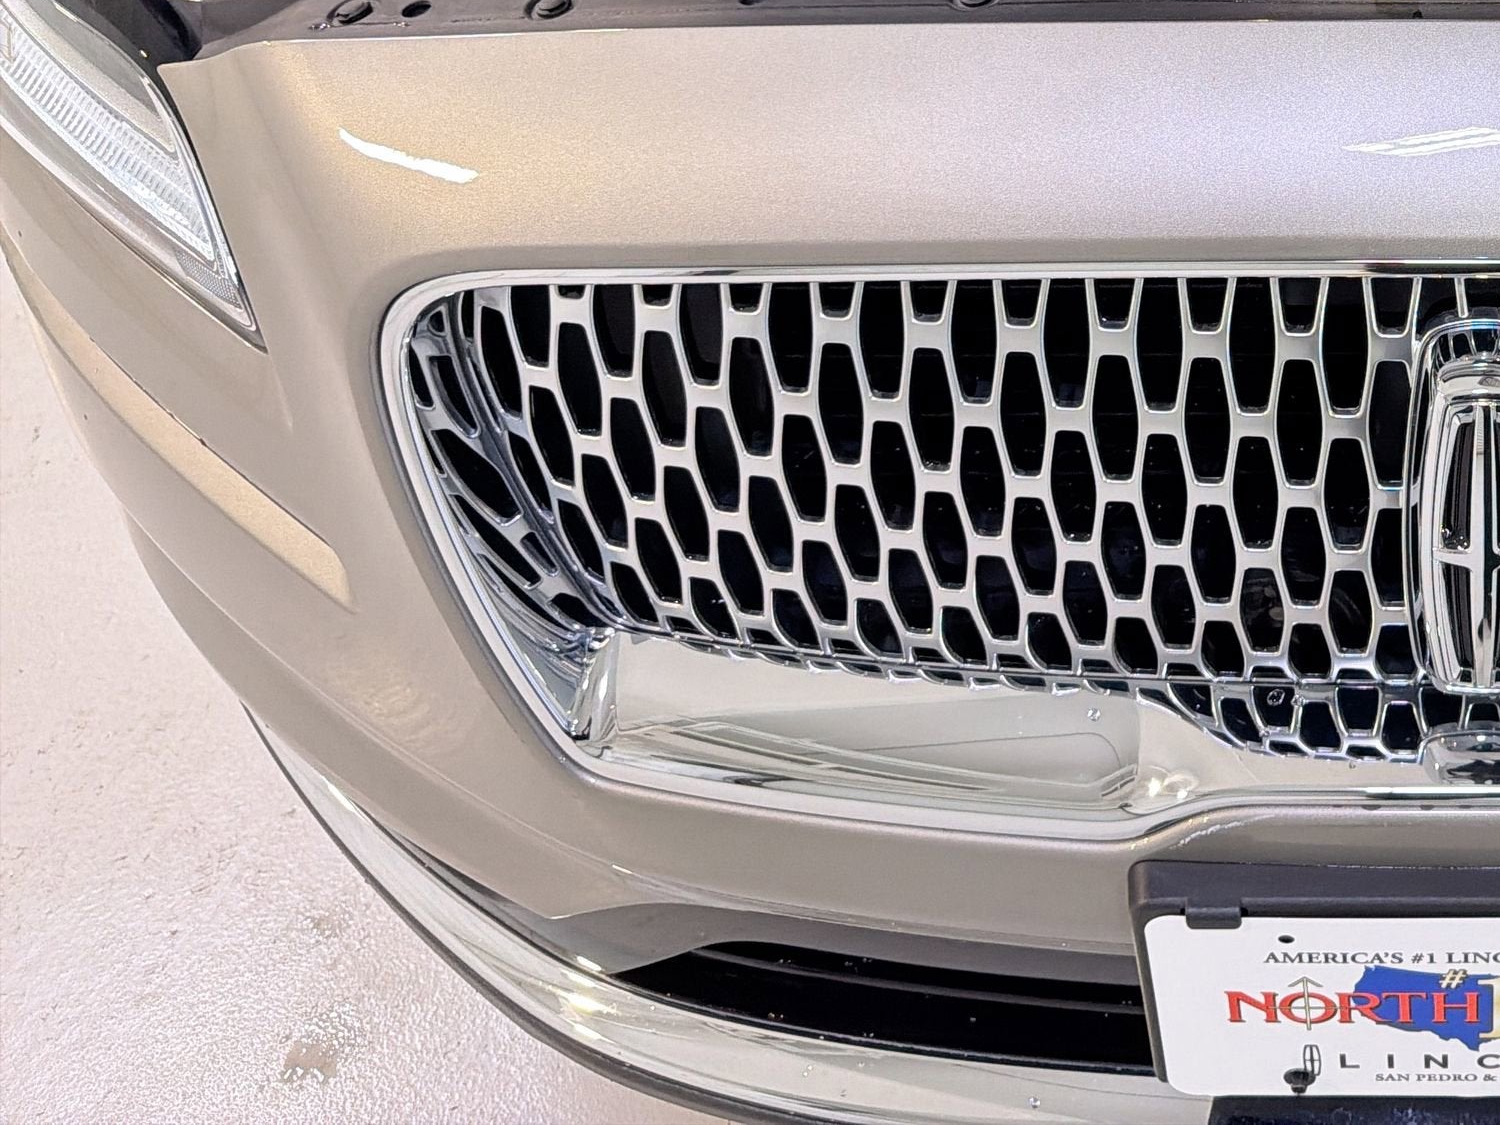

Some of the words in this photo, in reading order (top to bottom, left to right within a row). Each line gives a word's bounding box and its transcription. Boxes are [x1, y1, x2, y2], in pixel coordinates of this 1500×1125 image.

[1263, 951, 1404, 965] AMERICA'S
[1411, 952, 1437, 965] #1
[1224, 990, 1482, 1025] NORTH
[1375, 1073, 1410, 1082] SAN
[1416, 1073, 1478, 1082] PEDRO
[1483, 1073, 1498, 1082] &
